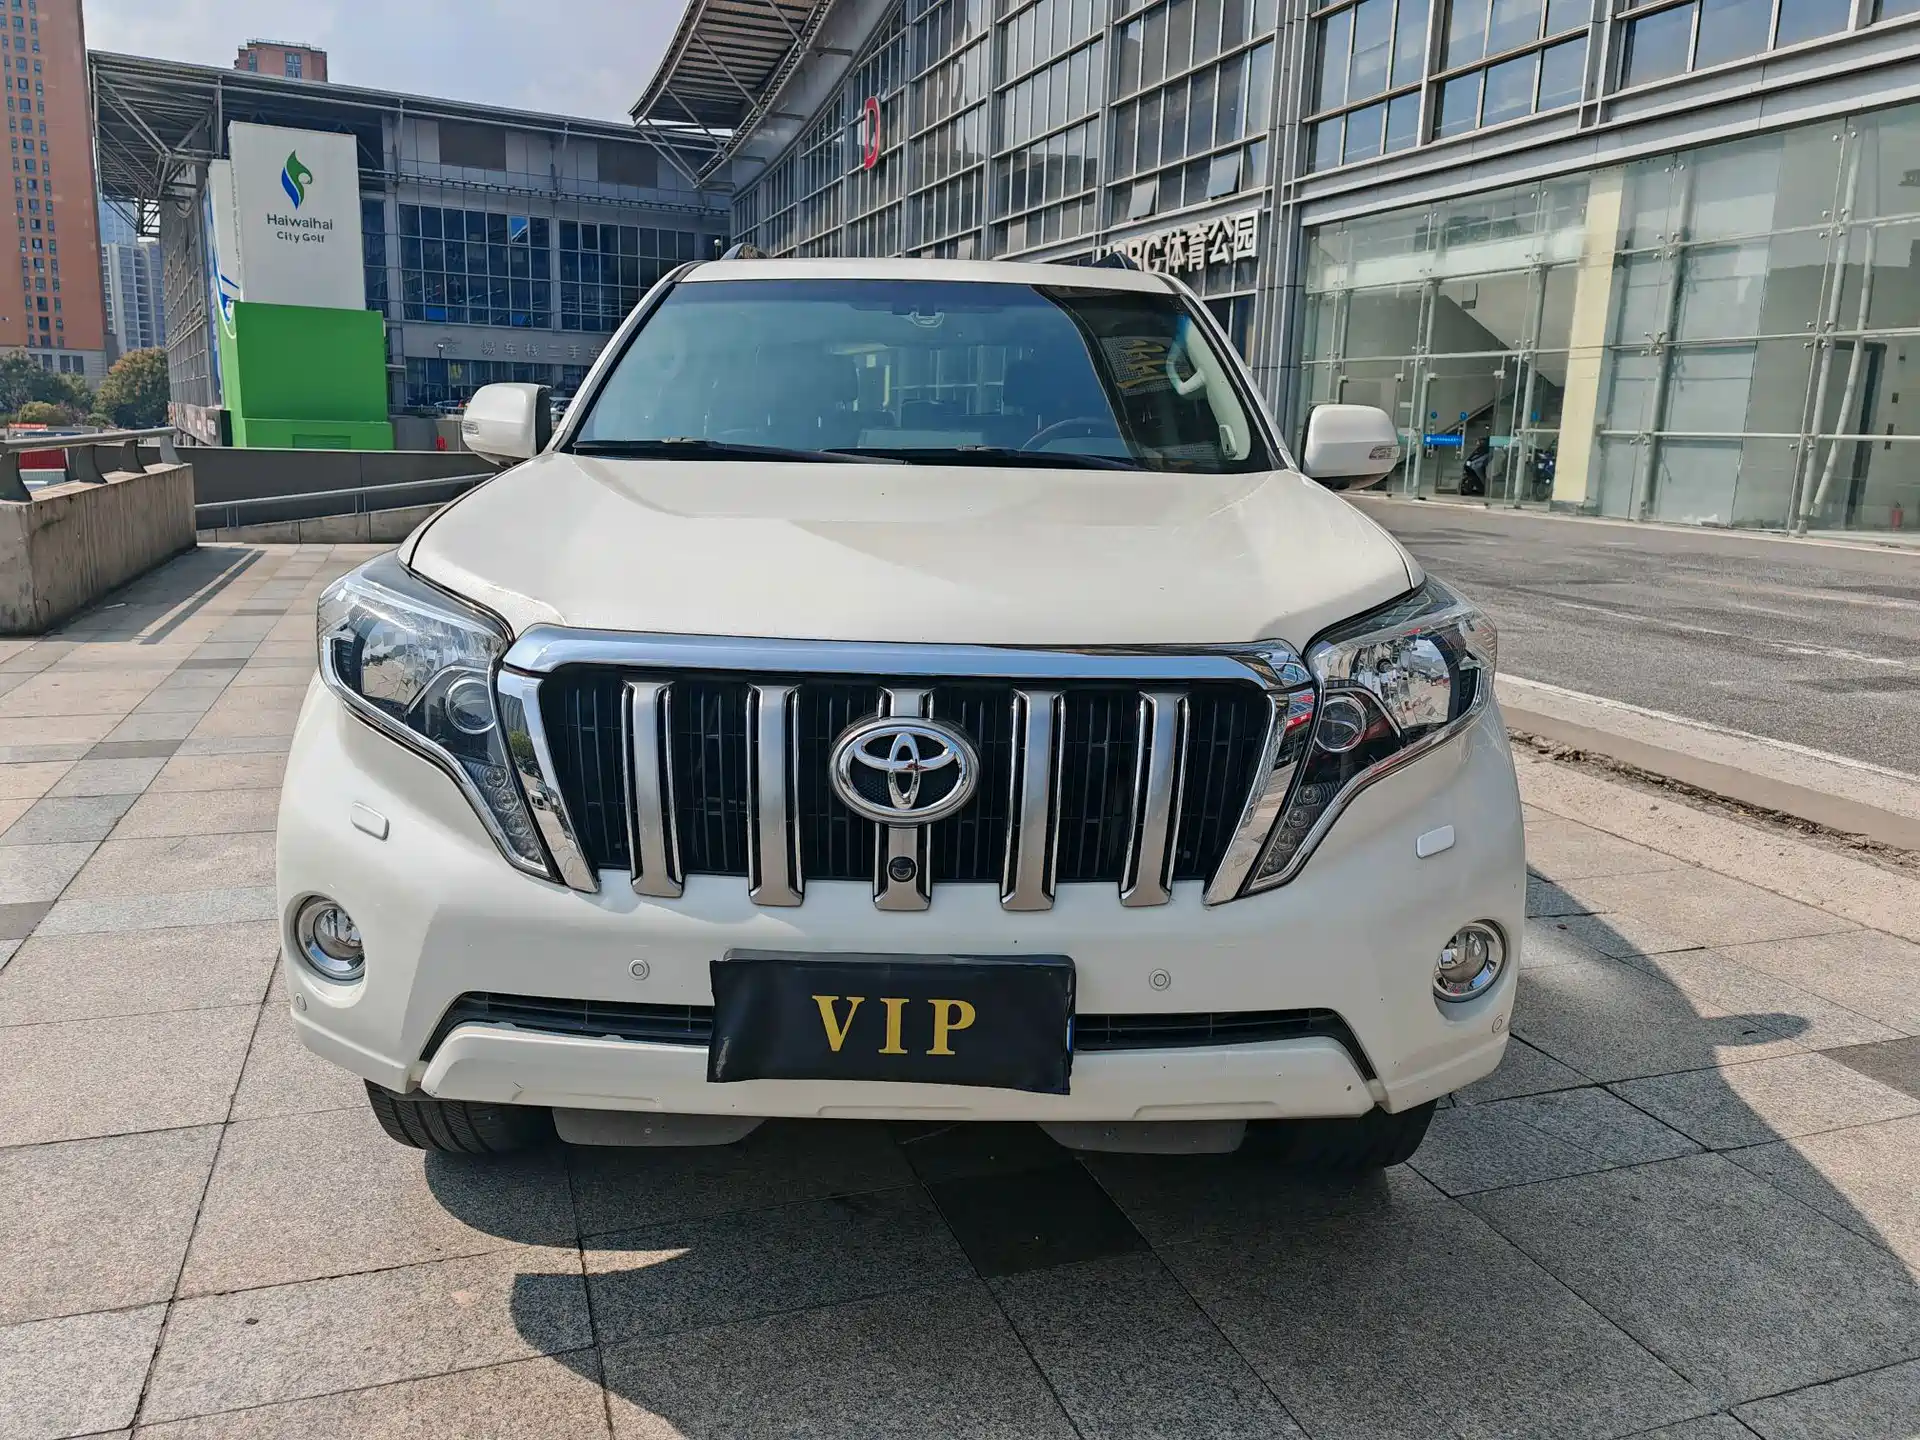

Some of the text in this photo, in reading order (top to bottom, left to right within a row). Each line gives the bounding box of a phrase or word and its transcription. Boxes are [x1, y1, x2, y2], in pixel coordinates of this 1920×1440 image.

[276, 231, 325, 243] City Golf
[812, 995, 976, 1056] VIP
